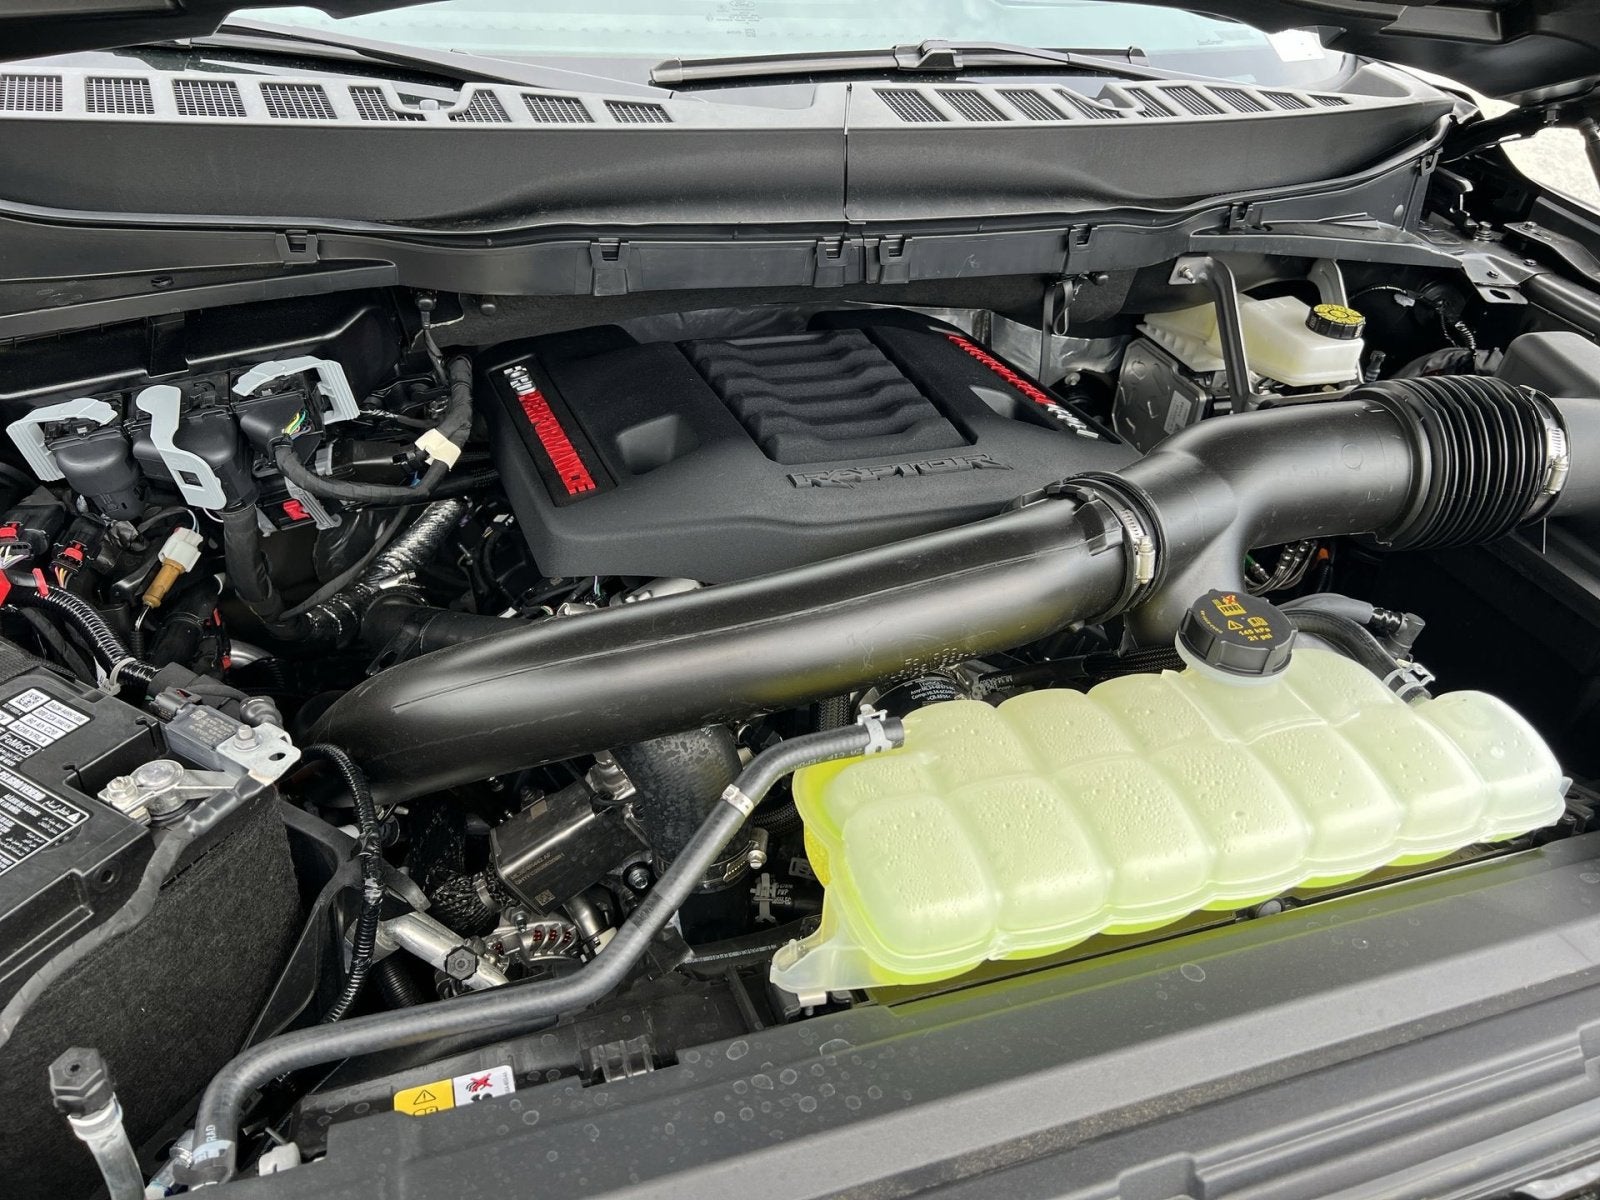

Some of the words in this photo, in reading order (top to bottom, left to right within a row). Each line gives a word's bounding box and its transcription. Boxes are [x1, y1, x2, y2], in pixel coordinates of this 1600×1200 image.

[786, 453, 1014, 490] RAPTOR
[1, 734, 33, 755] FoMoCo
[206, 1124, 217, 1142] RAD
